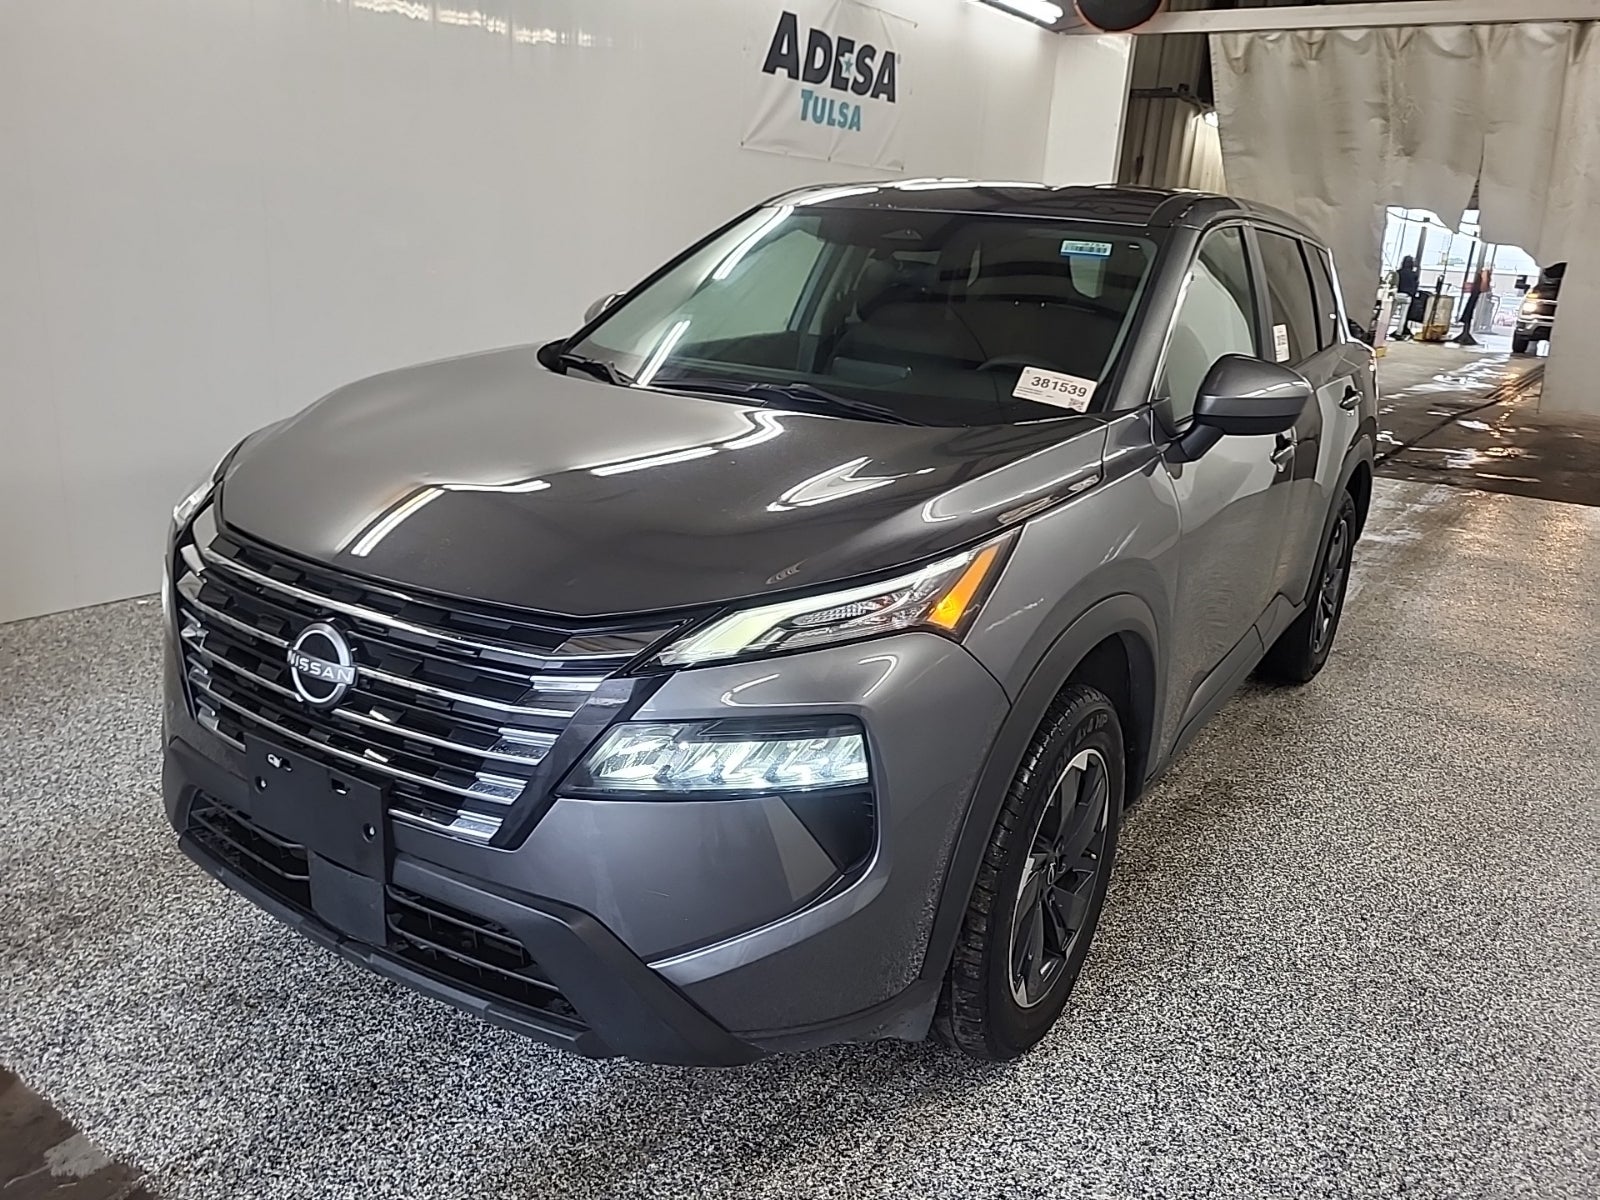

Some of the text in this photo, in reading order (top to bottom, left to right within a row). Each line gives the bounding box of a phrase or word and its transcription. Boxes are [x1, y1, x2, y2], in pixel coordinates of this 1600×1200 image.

[762, 10, 896, 103] ADESA
[801, 88, 861, 131] TULSA
[1030, 376, 1088, 398] 381539
[287, 649, 353, 682] NISSAN
